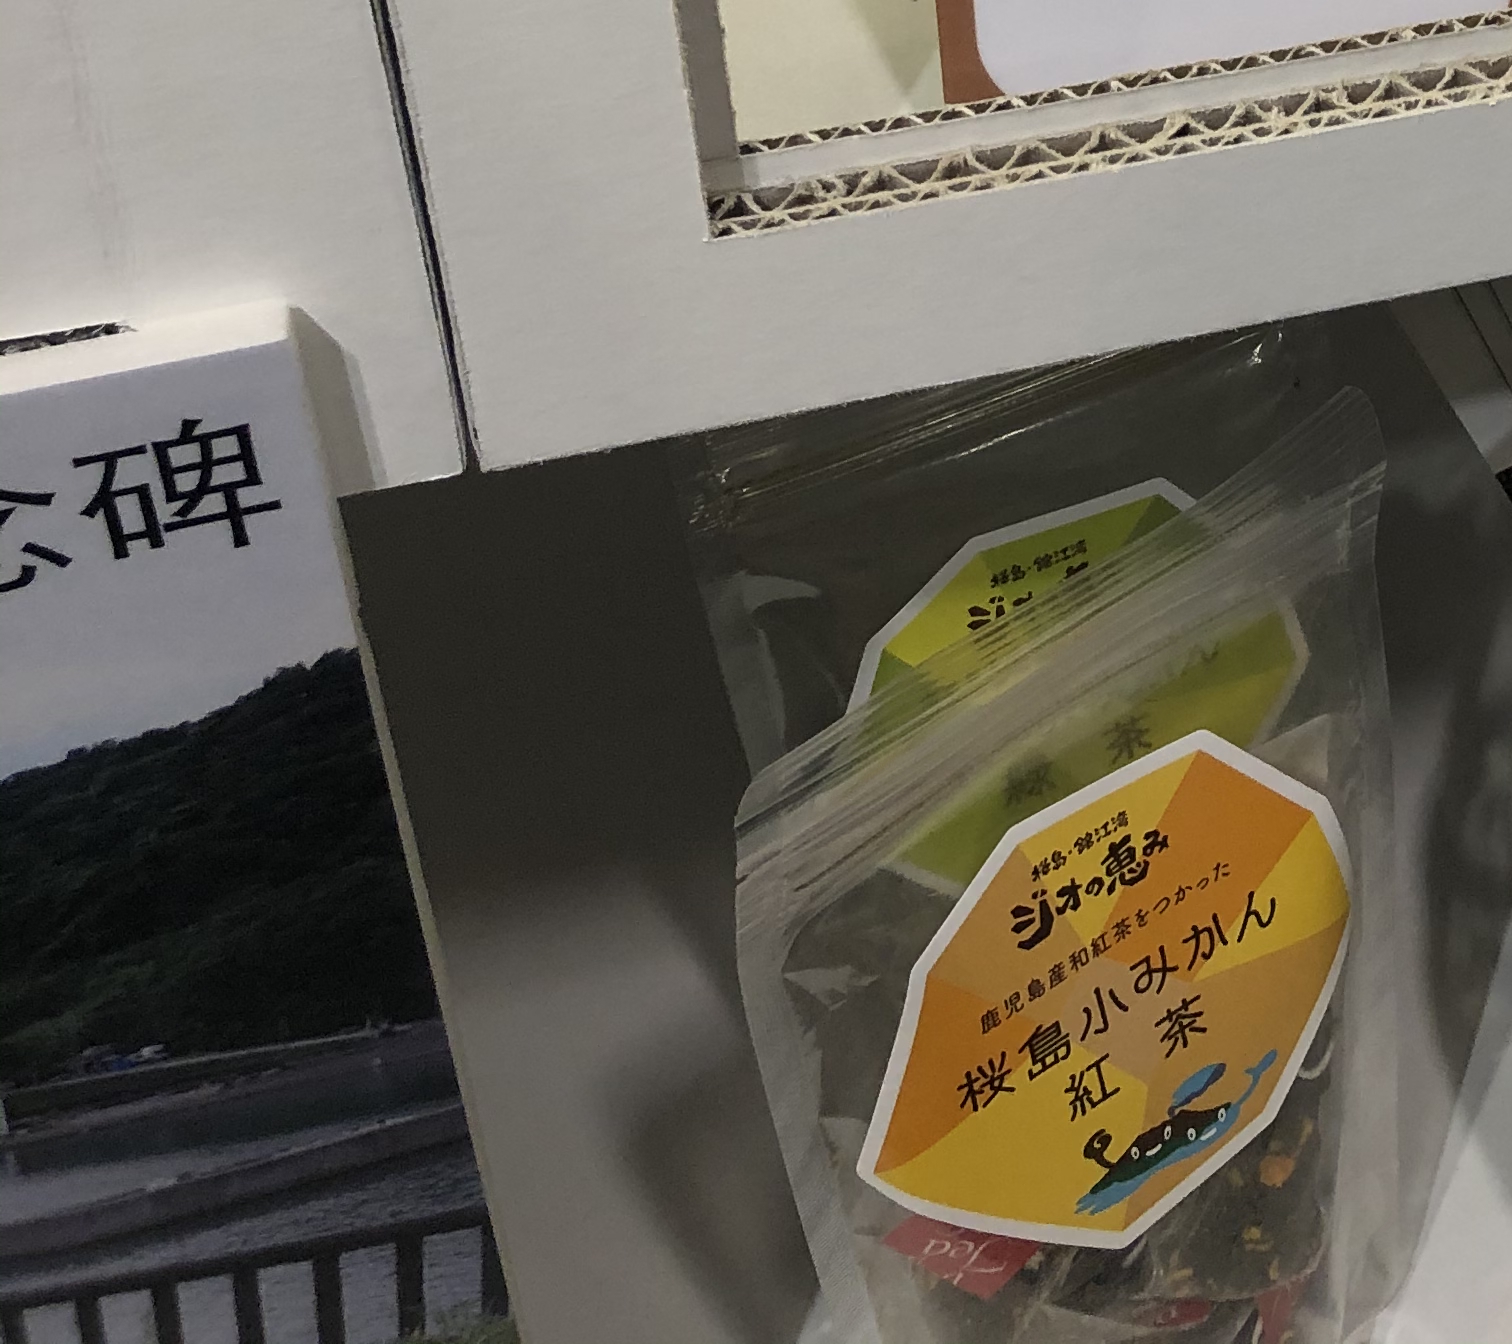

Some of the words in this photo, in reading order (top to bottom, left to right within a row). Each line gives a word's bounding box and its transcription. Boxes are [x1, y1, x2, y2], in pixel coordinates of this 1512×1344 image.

[980, 862, 1231, 1035] 鹿児島産和紅茶をつかった
[1010, 829, 1170, 950] ジオの恵み
[957, 890, 1276, 1112] 桜島小みかん
